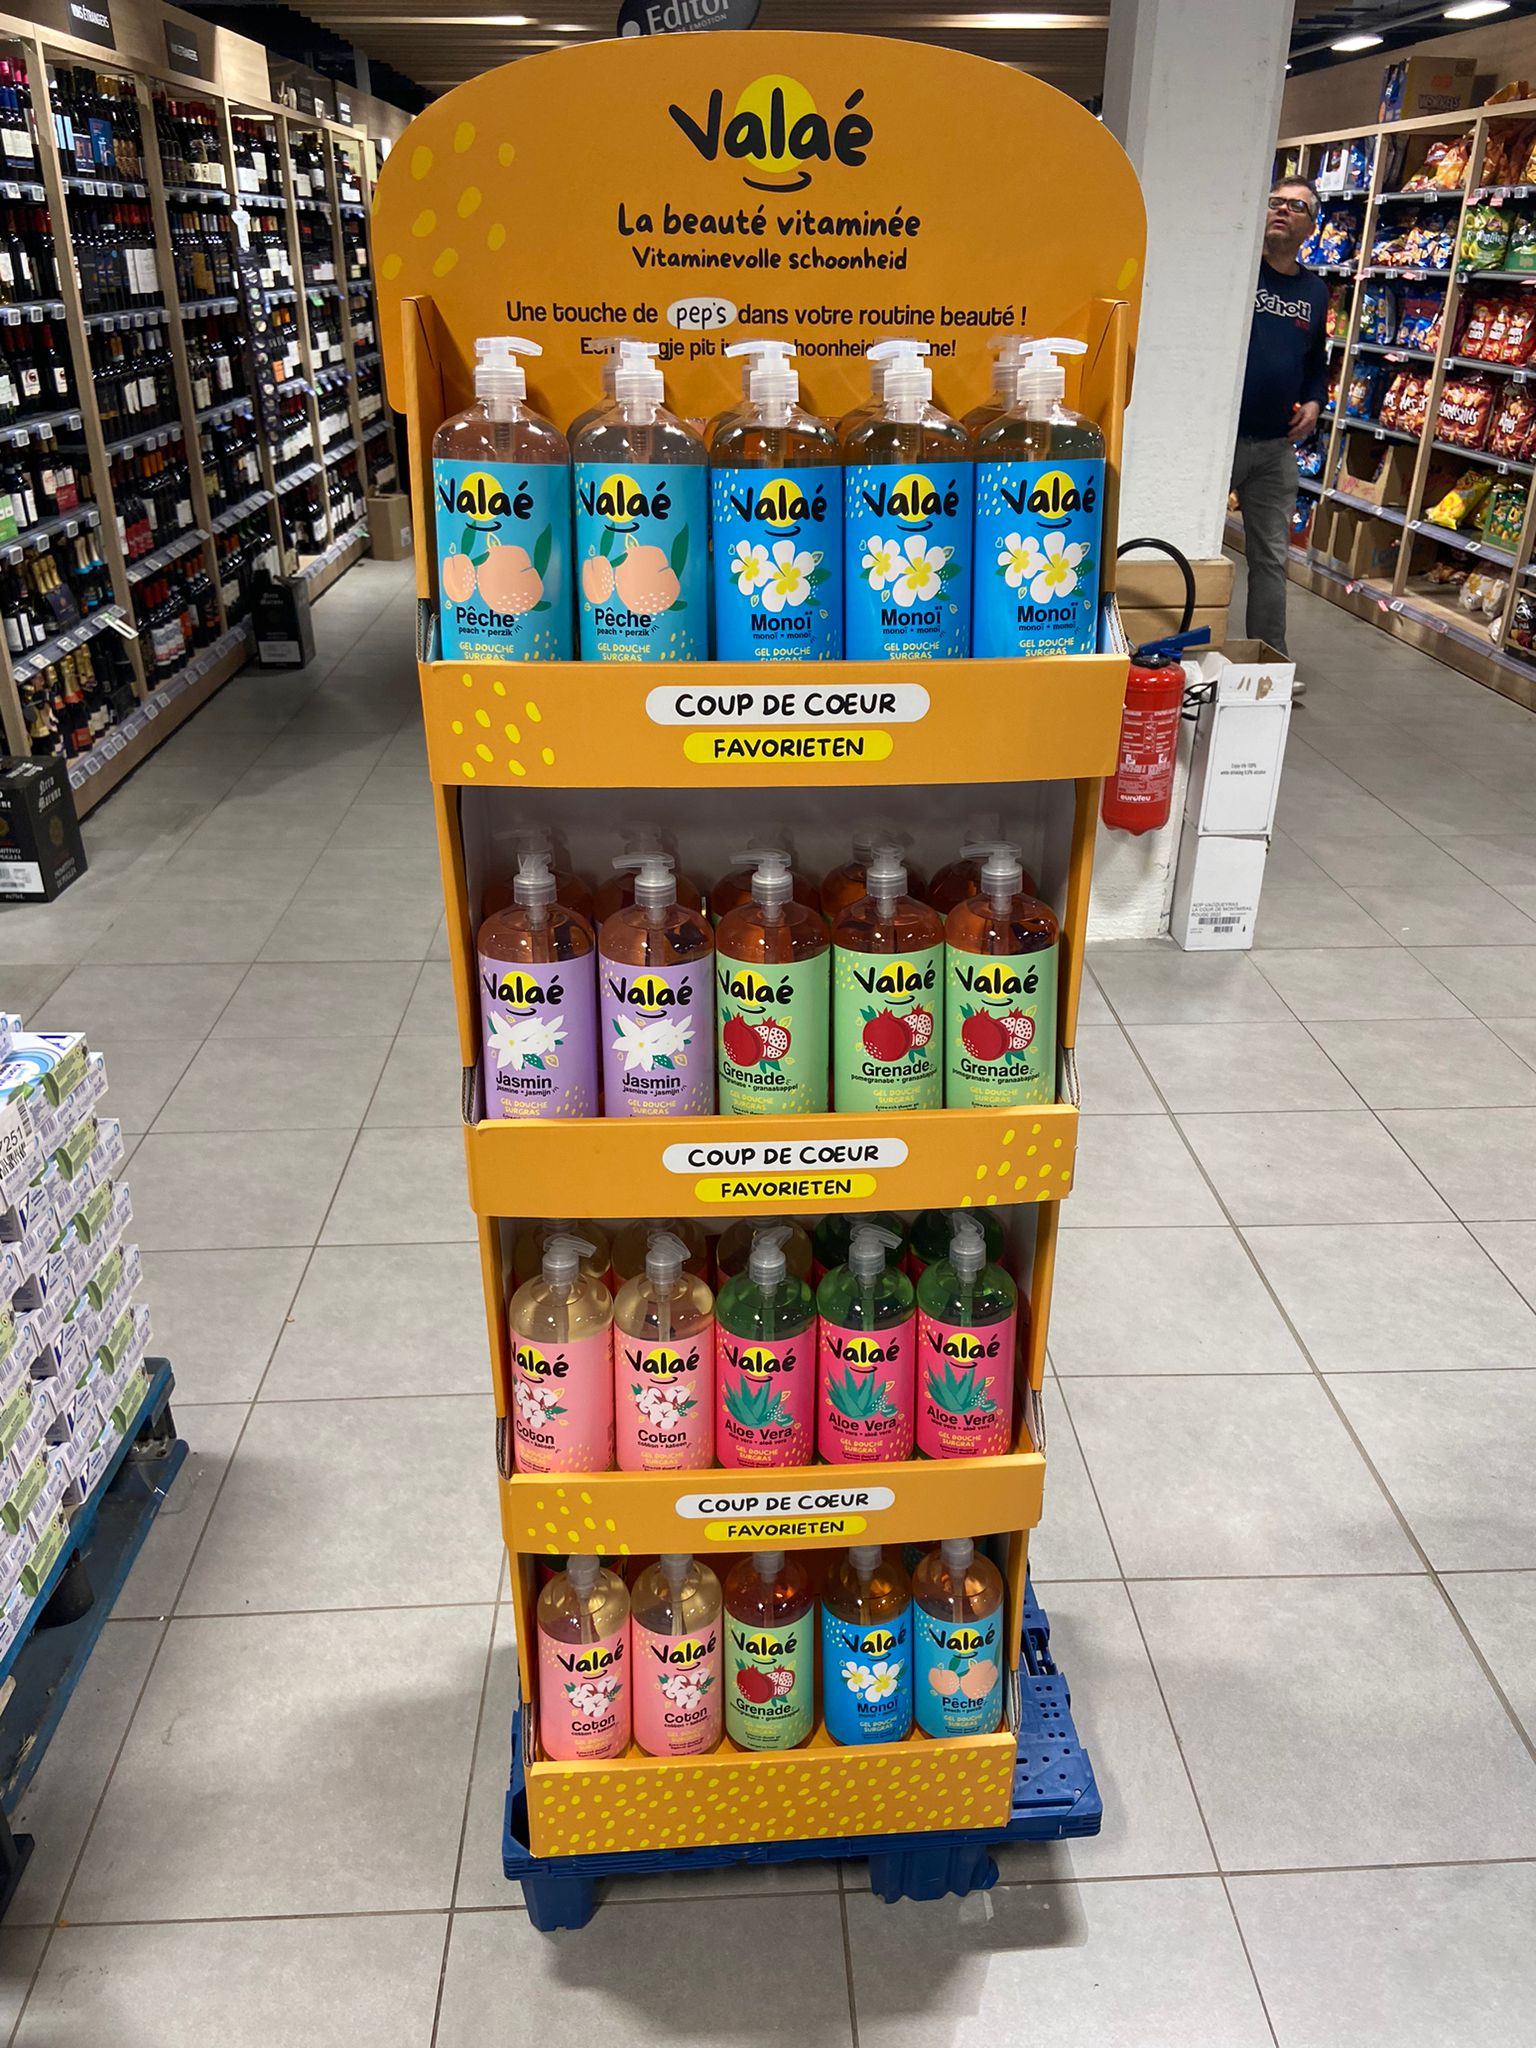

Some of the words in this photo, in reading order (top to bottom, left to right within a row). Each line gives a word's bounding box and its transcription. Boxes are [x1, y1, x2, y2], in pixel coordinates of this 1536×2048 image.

[668, 87, 873, 167] Valaé
[618, 202, 654, 236] La
[663, 203, 767, 236] beauté
[777, 205, 921, 237] vitaminée
[631, 245, 782, 269] Vitaminevolle
[788, 246, 907, 270] schoonheid
[506, 301, 547, 322] Une
[552, 302, 627, 323] touche
[632, 303, 658, 323] de
[676, 301, 727, 330] pep's
[738, 304, 788, 325] dans
[794, 305, 853, 325] votre
[859, 304, 935, 326] routine
[940, 305, 1015, 327] beauté
[690, 340, 716, 361] pit
[439, 477, 534, 519] Valaé
[579, 480, 671, 520] Valaé
[729, 484, 828, 523] Valaé
[862, 479, 959, 517] Valaé
[1000, 475, 1097, 515] Valaé
[456, 606, 515, 628] Pêche
[594, 606, 651, 628] Pêche
[751, 610, 813, 631] Monoï
[881, 606, 943, 627] Monoï
[1017, 602, 1078, 622] Monoï
[458, 626, 480, 636] peach
[488, 628, 512, 638] perzik
[597, 627, 617, 636] peach
[625, 629, 649, 638] perzik
[883, 627, 908, 635] monoï
[1019, 623, 1044, 631] monoï
[458, 641, 473, 653] GEL
[475, 643, 514, 654] DOUCHE
[597, 642, 611, 652] GEL
[612, 643, 650, 654] DOUCHE
[754, 648, 772, 657] GEL
[773, 647, 811, 656] DOUCHE
[884, 642, 901, 652] GEL
[902, 641, 940, 651] DOUCHE
[1019, 639, 1035, 648] GEL
[1038, 637, 1074, 648] DOUCHE
[1025, 647, 1067, 656] SURGRAS
[602, 653, 642, 661] SURGRAS
[889, 652, 932, 660] SURGRAS
[675, 693, 753, 718] COUP
[762, 693, 796, 717] DE
[713, 737, 864, 758] FAVORIETEN
[718, 969, 794, 1005] Valaé
[853, 960, 936, 994] Valaé
[955, 965, 1039, 995] Valaé
[483, 973, 565, 1006] Valaé
[608, 976, 693, 1007] Valaé
[723, 1061, 785, 1086] Grenade
[862, 1060, 930, 1079] Grenade
[960, 1058, 1030, 1077] Grenade
[496, 1070, 552, 1090] Jasmin
[622, 1072, 681, 1090] Jasmin
[688, 1148, 756, 1167] COUP
[764, 1147, 791, 1165] DE
[721, 1178, 851, 1198] FAVORIETEN
[826, 1336, 901, 1364] Valaé
[926, 1330, 1001, 1358] Valaé
[512, 1342, 569, 1378] Valaé
[625, 1346, 700, 1375] Valaé
[723, 1343, 797, 1373] Valaé
[828, 1412, 859, 1431] Aloe
[864, 1418, 897, 1432] Vera
[927, 1405, 958, 1426] Aloe
[963, 1413, 995, 1427] Vera
[516, 1420, 555, 1445] Coton
[638, 1430, 687, 1444] Coton
[725, 1419, 754, 1439] Aloe
[759, 1426, 793, 1440] Vera
[698, 1498, 759, 1513] COUP
[766, 1497, 791, 1511] DE
[728, 1520, 845, 1538] FAVORIETEN
[651, 1630, 717, 1664] Valaé
[731, 1629, 798, 1655] Valaé
[841, 1622, 907, 1654] Valaé
[928, 1623, 996, 1650] Valaé
[556, 1637, 625, 1673] Valaé
[736, 1698, 791, 1716] Grenade
[942, 1696, 984, 1709] Pêche
[571, 1713, 616, 1733] Coton
[664, 1707, 708, 1724] Coton
